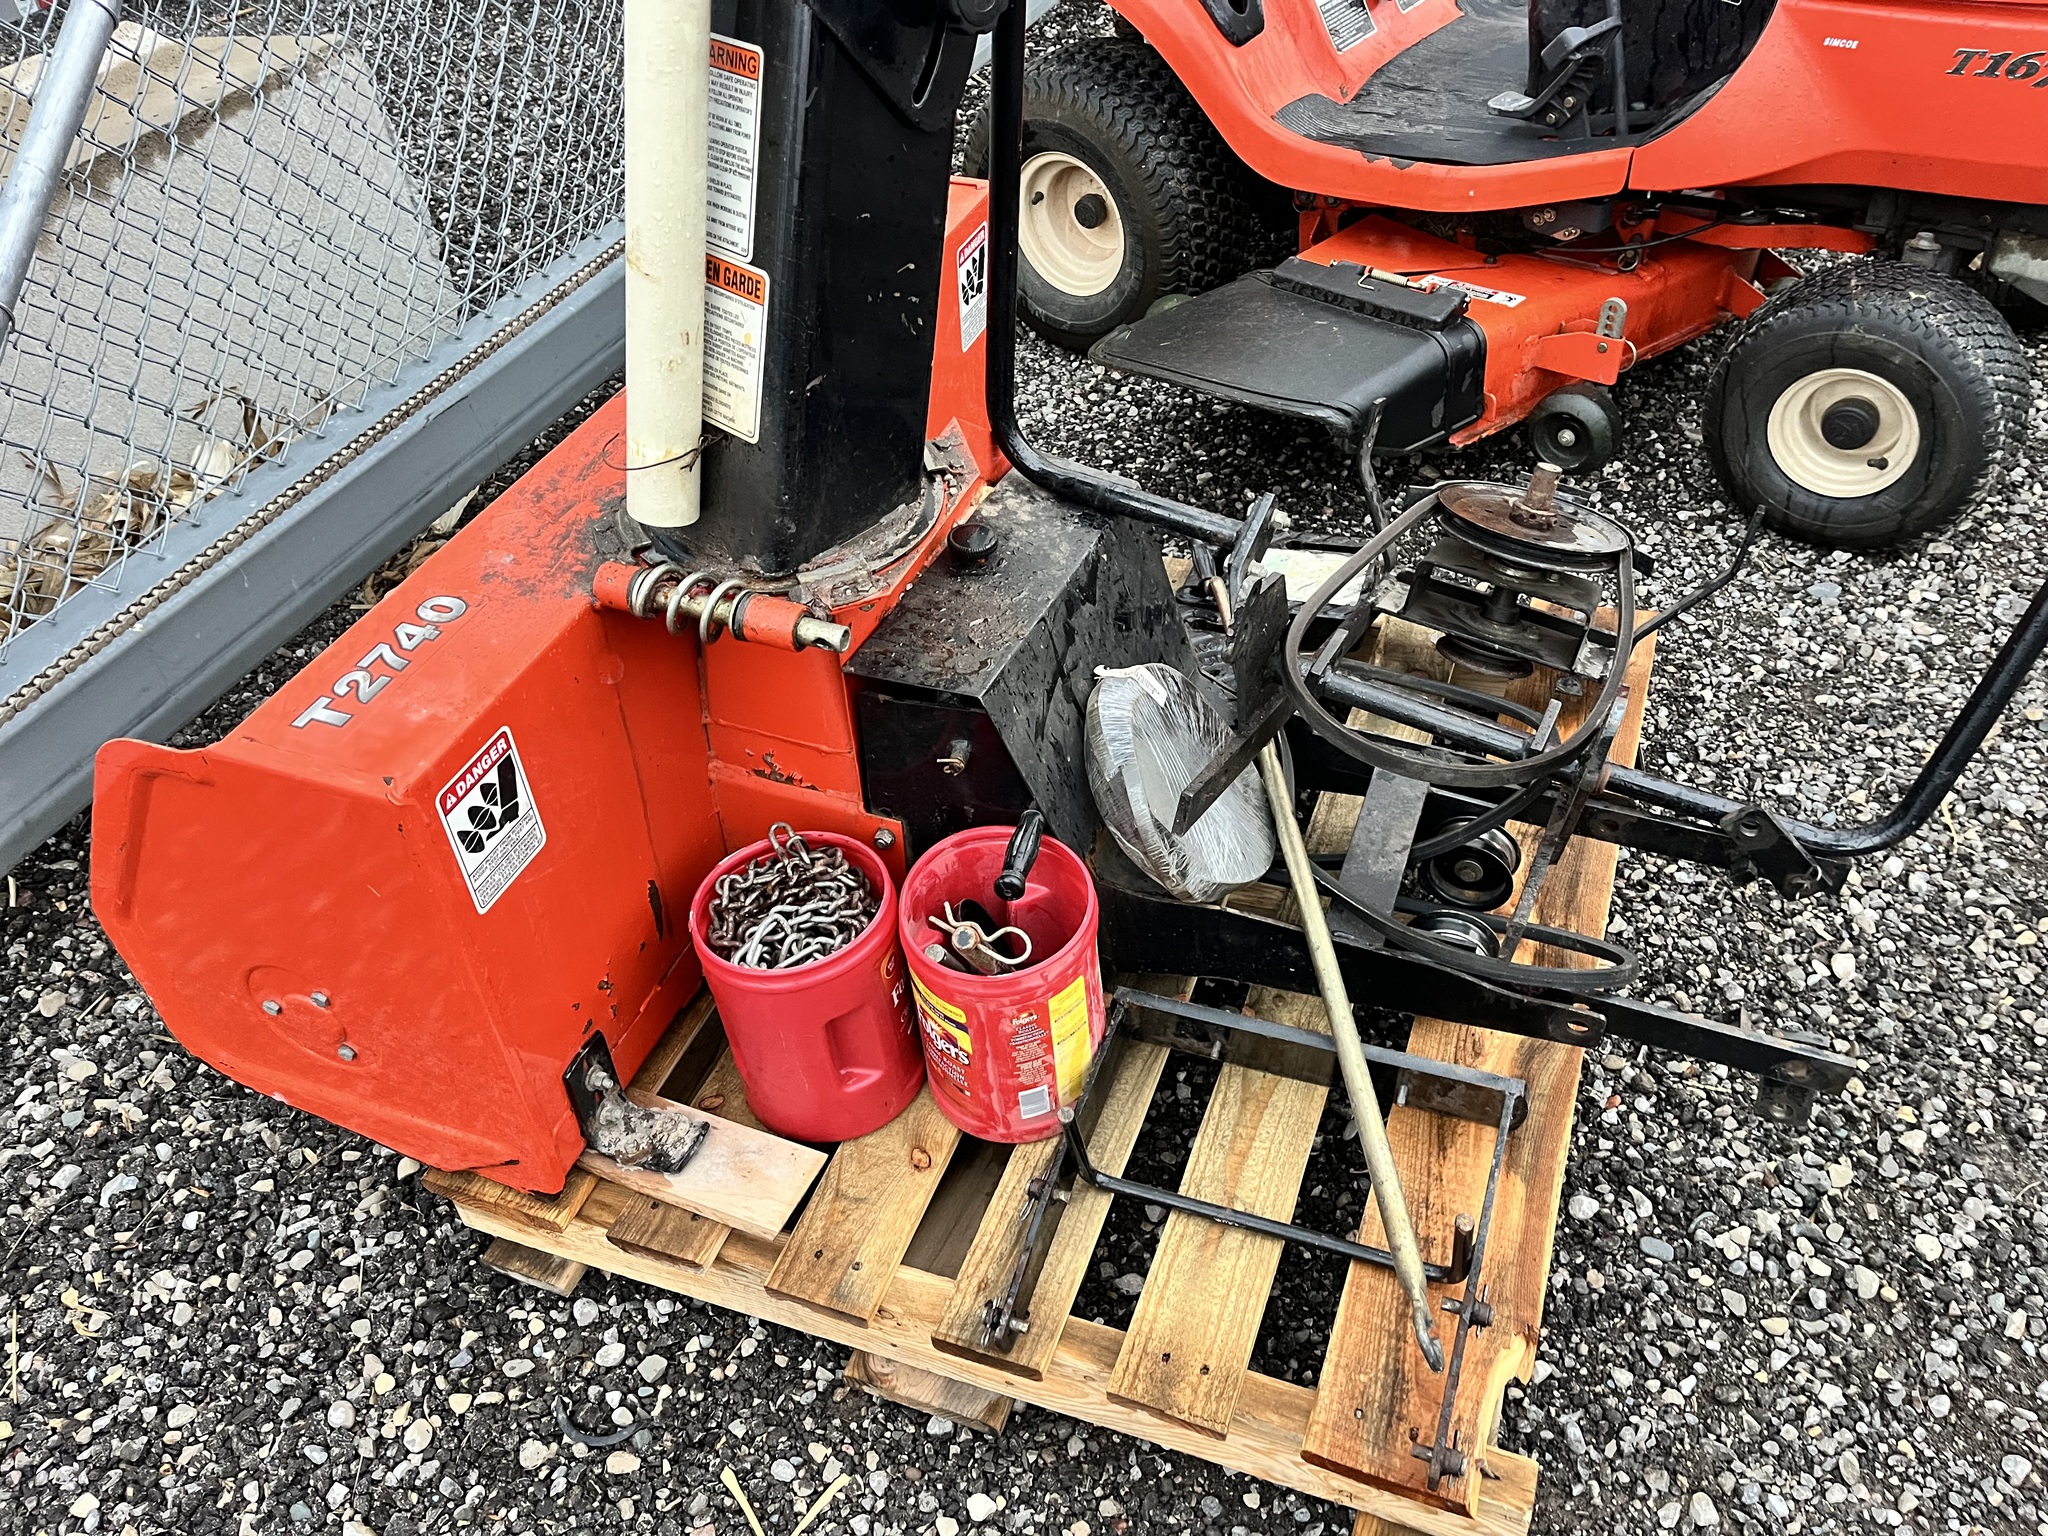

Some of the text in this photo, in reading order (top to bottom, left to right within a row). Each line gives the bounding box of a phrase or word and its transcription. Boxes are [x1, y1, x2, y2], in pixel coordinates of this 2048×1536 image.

[1823, 37, 1859, 49] SIMCOE
[710, 46, 757, 74] ARNING
[724, 266, 761, 299] GARDE
[290, 595, 470, 730] T2740
[455, 737, 507, 796] DANGER
